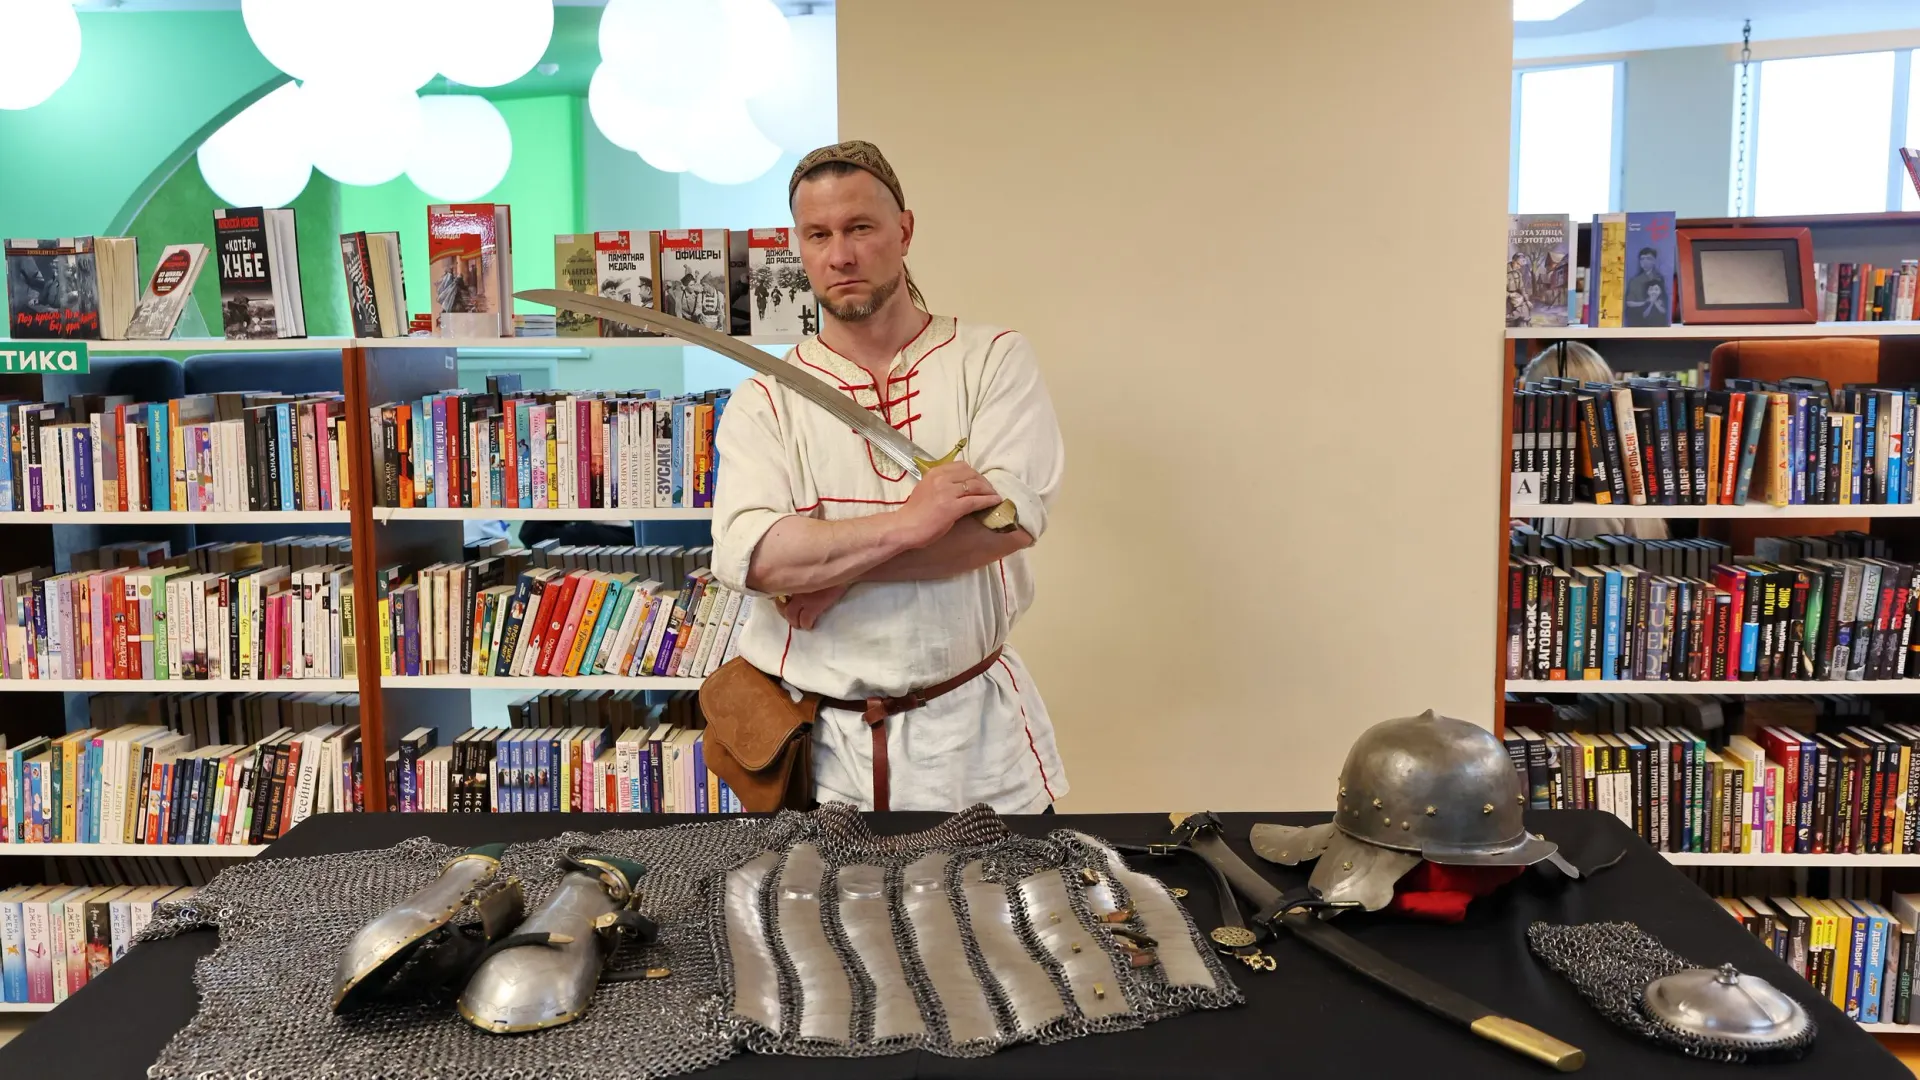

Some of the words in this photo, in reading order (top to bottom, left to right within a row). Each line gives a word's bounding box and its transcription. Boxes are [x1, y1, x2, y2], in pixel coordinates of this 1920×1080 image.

[222, 253, 266, 278] ХУБЕ
[608, 253, 644, 262] ПАМЯТНАЯ
[608, 262, 636, 271] МЕДАЛЬ
[676, 250, 722, 262] ОФИЦЕРЫ
[0, 350, 77, 371] тика
[1586, 402, 1595, 426] ТЕЙЛОР
[1867, 397, 1875, 428] Андреева
[1590, 426, 1598, 448] АДАМС
[1729, 422, 1739, 461] СНЕЖНАЯ
[1865, 431, 1874, 457] Наталья
[269, 438, 277, 479] ОДНАЖДЫ,
[305, 441, 313, 473] НЕЖНАЯ
[436, 446, 444, 463] ЗИМА
[540, 460, 544, 468] ОТ
[1541, 450, 1550, 483] Абдуллаев
[1554, 450, 1562, 483] Абдуллаев
[1567, 450, 1575, 483] Абдуллаев
[657, 448, 670, 494] ЗУСАК
[1516, 478, 1532, 494] А
[1598, 462, 1606, 482] ВЫХОДА
[1726, 462, 1735, 495] королева
[306, 476, 315, 504] ВОЙНА
[1868, 571, 1877, 591] ДЭН
[1764, 583, 1776, 615] ПАДШИЕ
[1778, 587, 1791, 608] ФИКС
[1863, 593, 1874, 621] БРАУН
[1574, 606, 1582, 638] БРАУН
[1718, 606, 1727, 633] КАИНА
[119, 625, 127, 667] Веденская
[1539, 611, 1552, 669] ЗАГОВОР
[1716, 635, 1725, 654] ОКО
[1778, 620, 1787, 651] БОЛДАЧЧИ
[288, 762, 296, 776] РАЙ
[1695, 766, 1703, 798] ГЕРРИТСЕН
[1908, 753, 1916, 798] СМЕРТЕЛЬНЫЙ
[619, 776, 629, 807] КУНДЕРА
[631, 778, 639, 809] КУНДЕРА
[1838, 766, 1849, 816] ГРАНОВСКИЕ
[1861, 765, 1871, 815] ГРАНОВСКИЕ
[1873, 773, 1883, 798] ГРАНЖЕ
[266, 813, 277, 831] Череп
[272, 786, 281, 803] флаге
[1871, 798, 1881, 843] ЖАН-КРИСТОФ
[1902, 811, 1912, 846] АНДРЕАС
[4, 906, 12, 941] ДЖЕЙН
[28, 906, 37, 941] ДЖЕЙН
[67, 906, 75, 940] ДЖЕЙН
[112, 906, 120, 941] ДЖЕЙН
[1854, 931, 1865, 968] ДЕЛЬВИГ
[1870, 931, 1881, 967] ДЕЛЬВИГ
[1901, 971, 1910, 998] ДИВЕР
